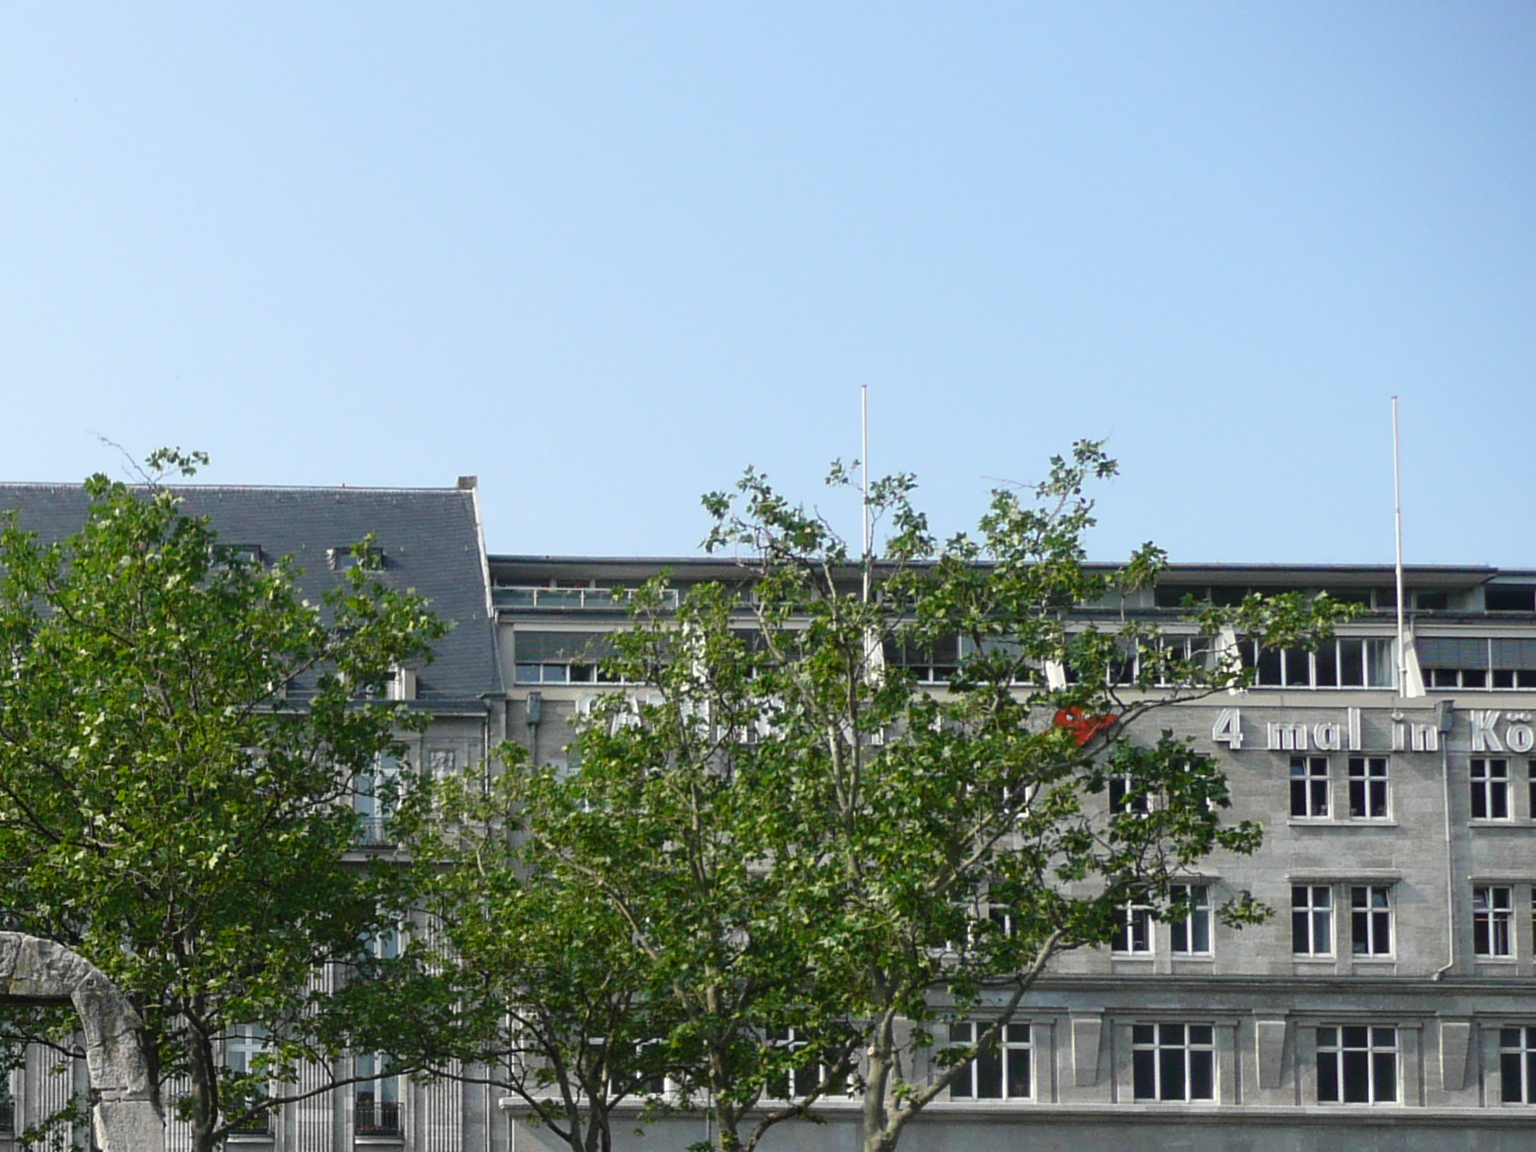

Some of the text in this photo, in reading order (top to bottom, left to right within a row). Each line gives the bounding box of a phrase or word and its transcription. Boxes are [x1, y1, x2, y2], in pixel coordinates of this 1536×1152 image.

[1212, 708, 1243, 749] 4
[1267, 707, 1361, 750] mal
[1390, 711, 1438, 750] in
